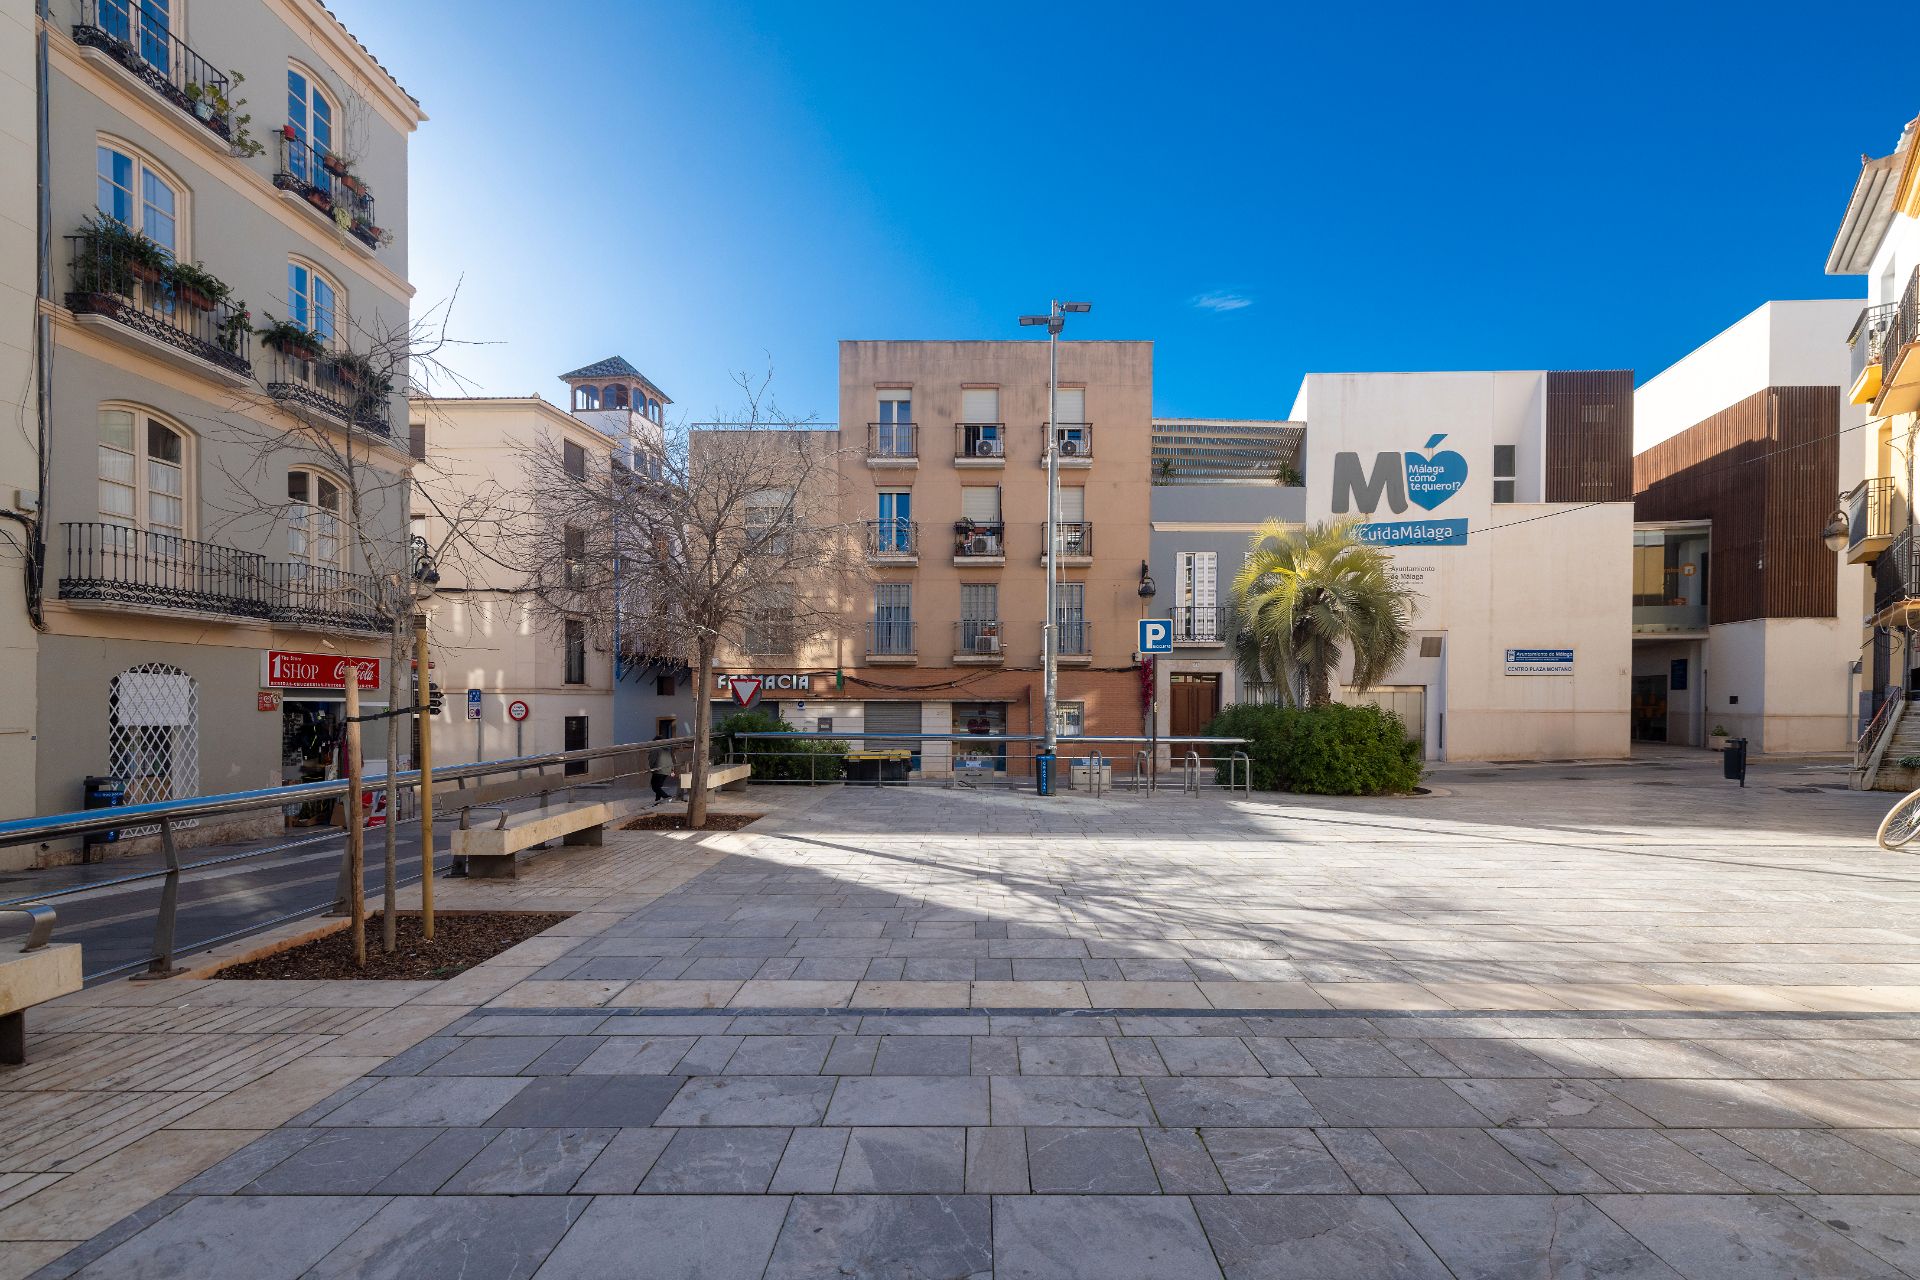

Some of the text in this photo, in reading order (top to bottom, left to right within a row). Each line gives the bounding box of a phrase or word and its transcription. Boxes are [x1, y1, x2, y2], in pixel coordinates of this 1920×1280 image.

[1408, 463, 1445, 475] Málaga
[1409, 473, 1437, 482] cómo
[1410, 483, 1421, 491] te
[1146, 624, 1166, 649] P
[282, 663, 319, 680] SHOP
